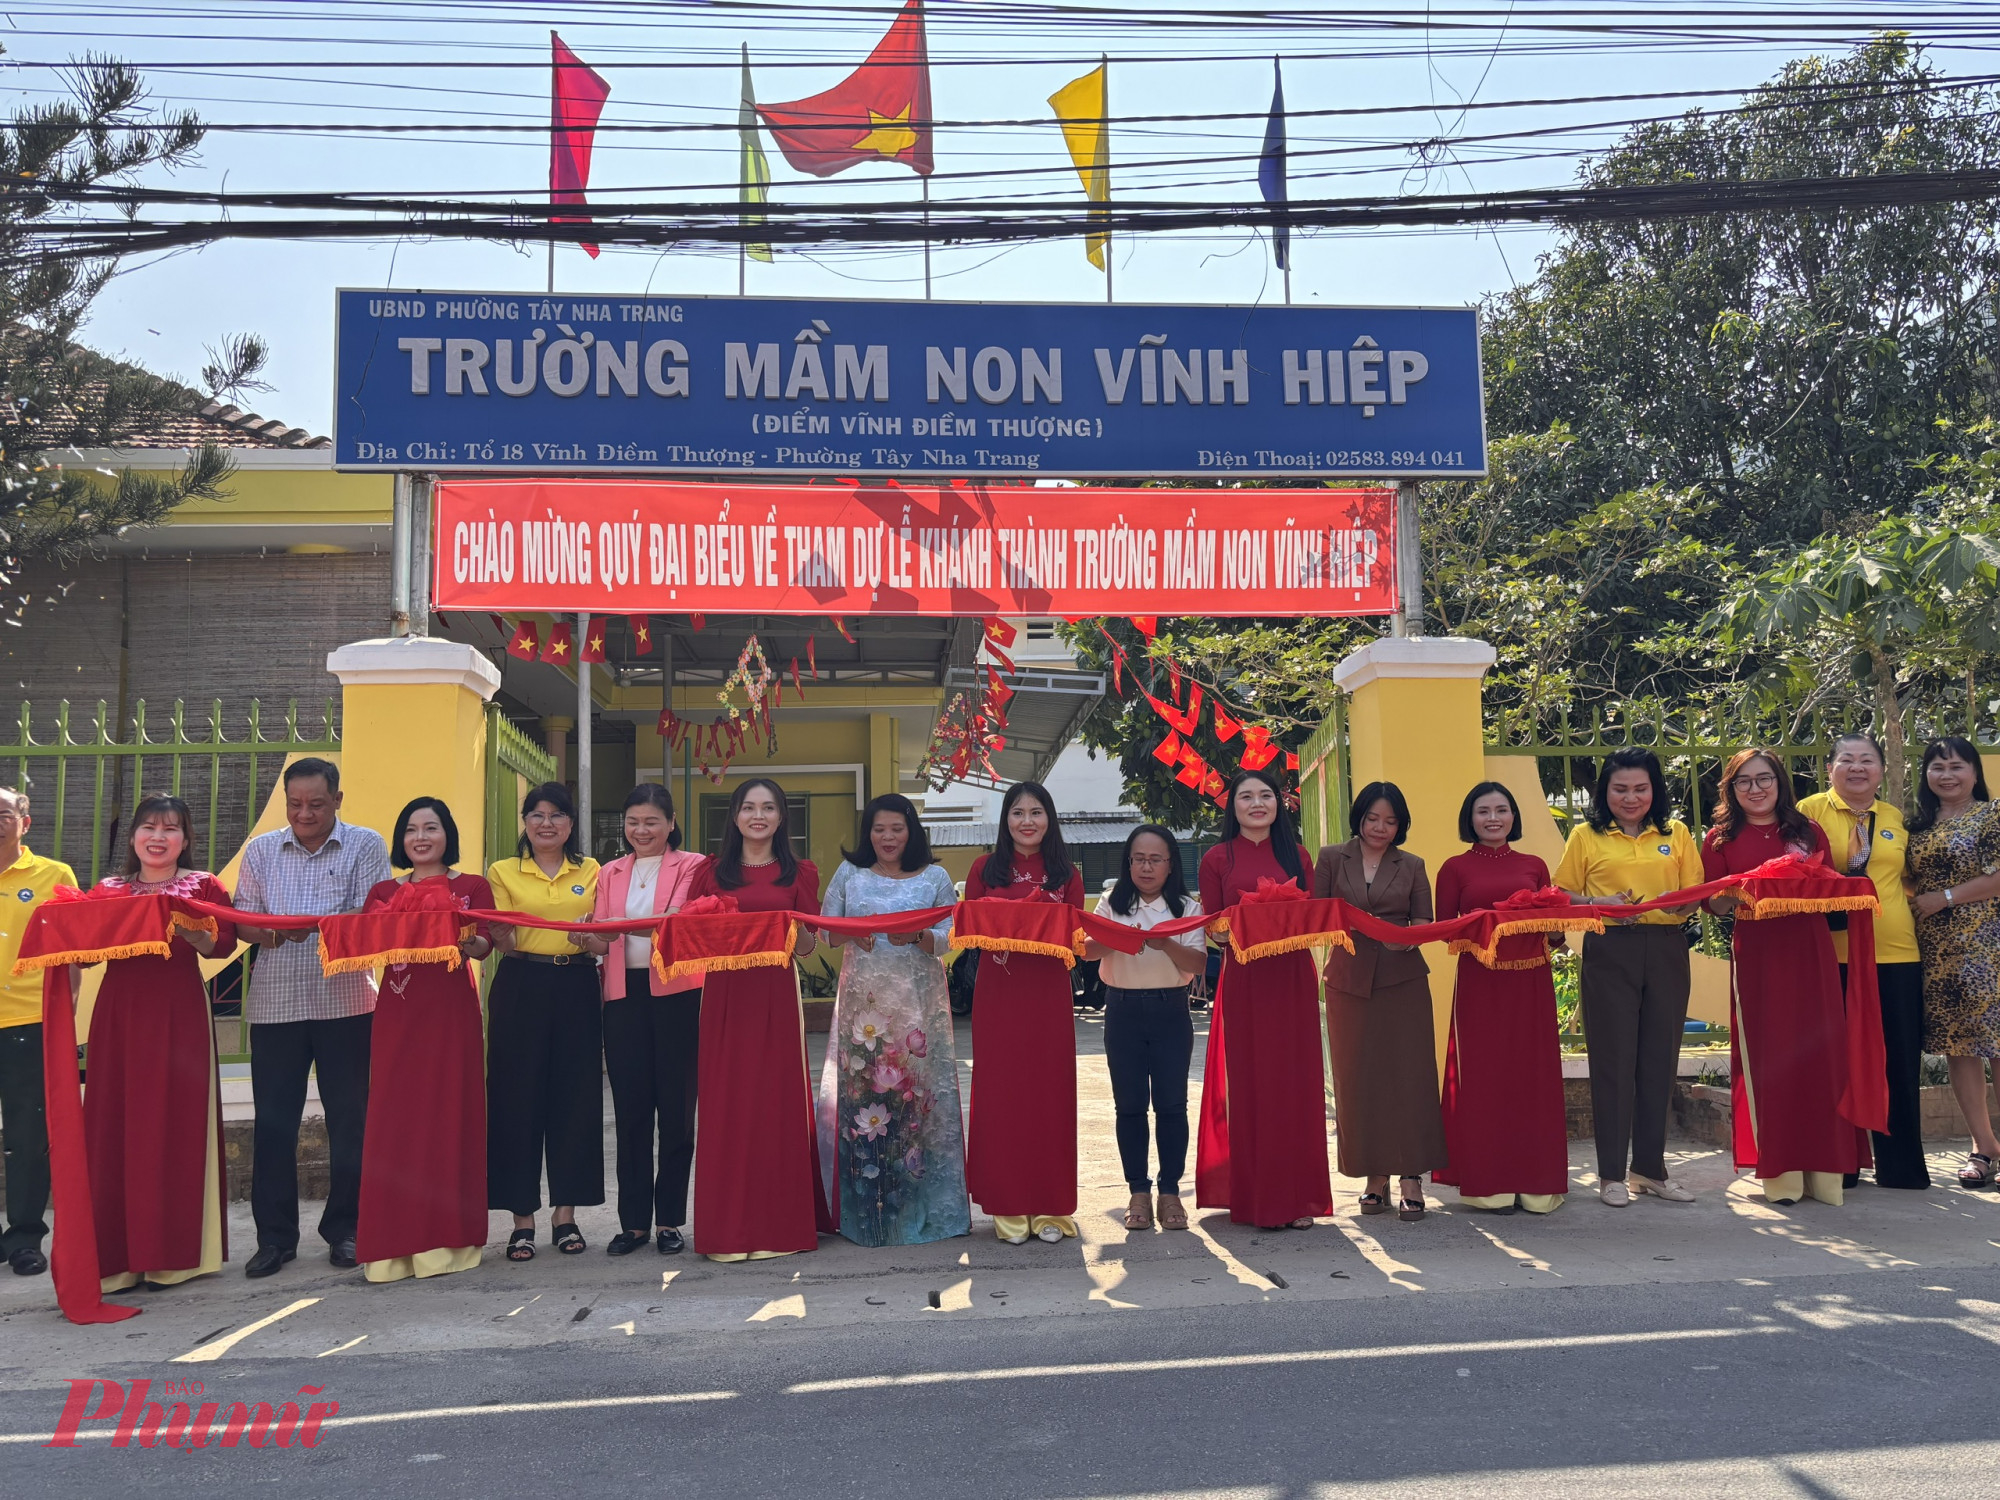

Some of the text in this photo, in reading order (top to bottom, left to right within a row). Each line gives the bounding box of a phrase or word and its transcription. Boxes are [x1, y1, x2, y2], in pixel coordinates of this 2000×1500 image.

[370, 297, 682, 322] UBND PHƯỜNG TÂY NHA TRANG
[397, 319, 1429, 418] TRƯỜNG MẦM NON VĨNH HIỆP
[752, 406, 1102, 442] (ĐIỂM VĨNH ĐIỀM THƯỢNG)
[357, 443, 398, 462] Địa
[407, 442, 455, 459] Chỉ:
[464, 439, 494, 459] Tổ
[502, 444, 523, 459] 18
[532, 444, 586, 460] Vĩnh
[598, 442, 657, 460] Điềm
[667, 446, 755, 466] Thượng
[775, 447, 861, 467] Phường
[872, 448, 913, 467] Tây
[923, 450, 967, 464] Nha
[974, 450, 1040, 468] Trang
[1198, 450, 1248, 469] Điện
[1326, 451, 1426, 465] 02583.894
[1432, 451, 1464, 465] 041
[454, 498, 1377, 601] CHÀO MỪNG QUÝ ĐẠI BIỂU VỀ THAM DỰ LỄ KHÁNH THÀNH TRƯỜNG MẦM NON VĨNH HIỆP
